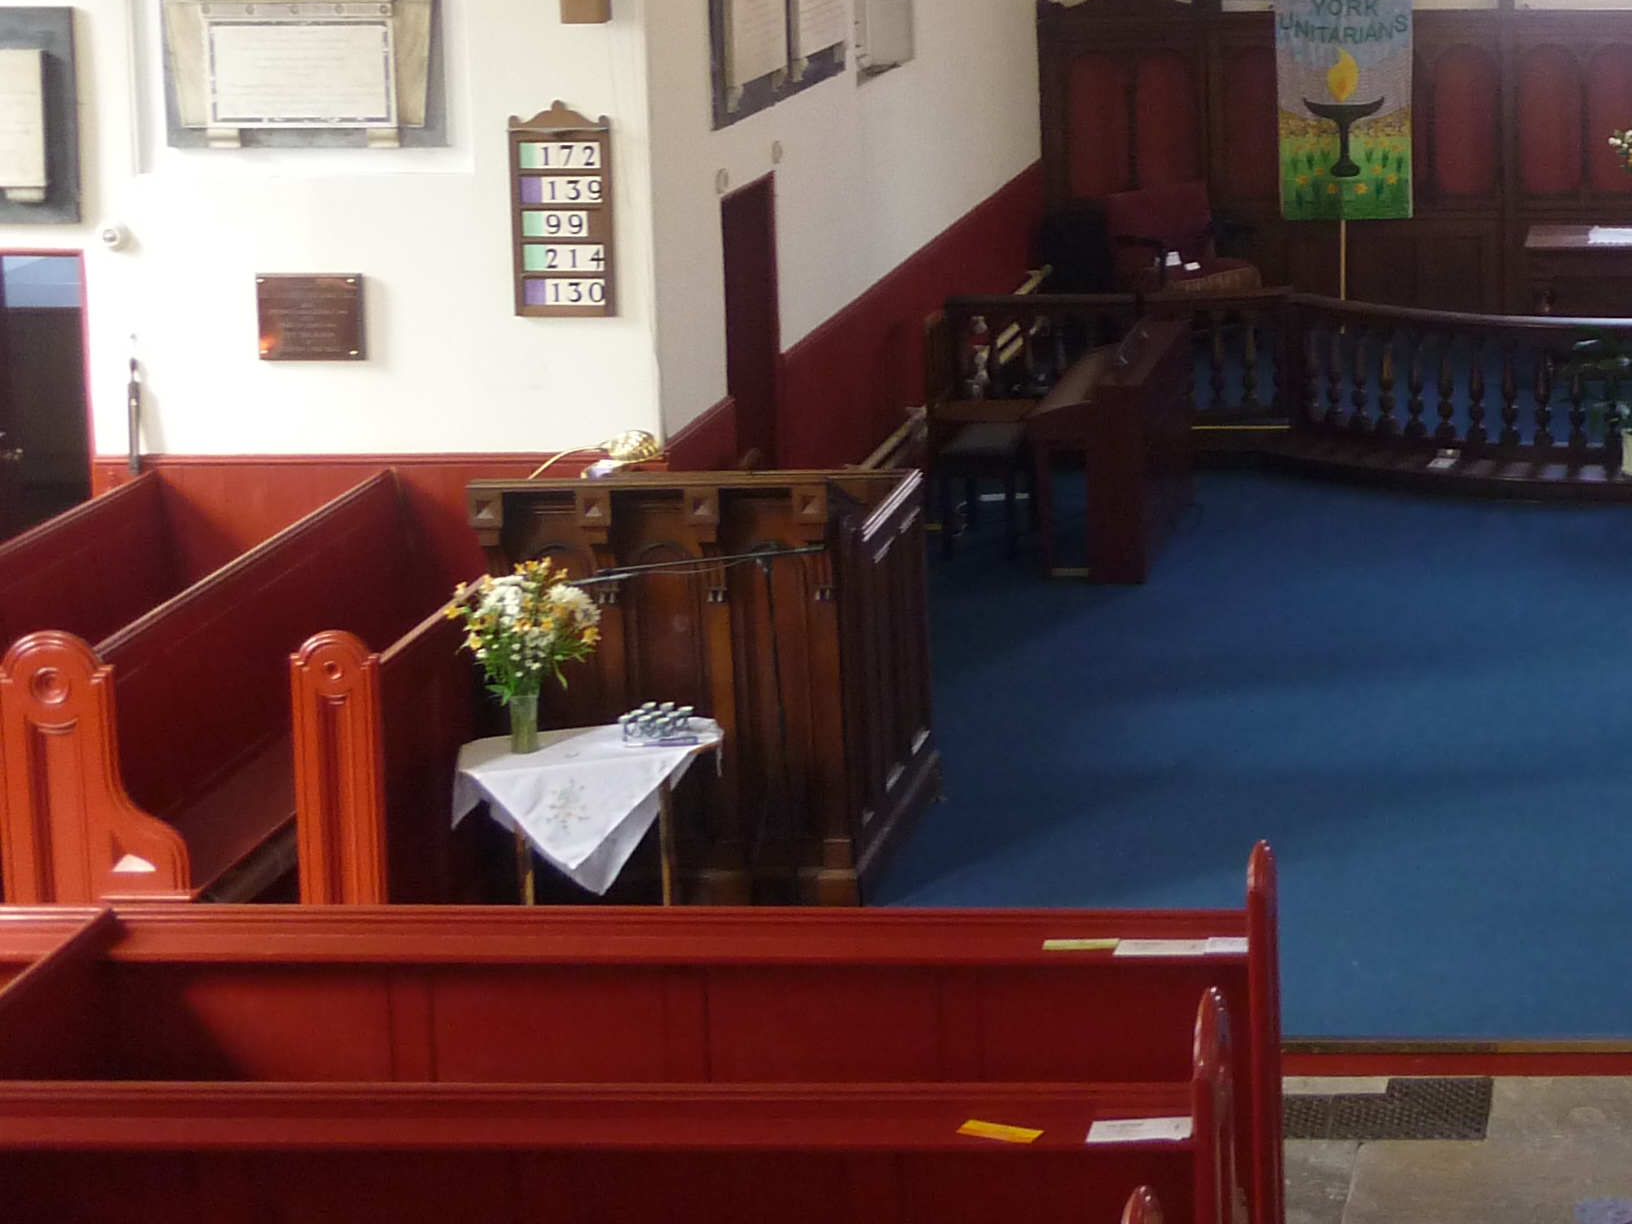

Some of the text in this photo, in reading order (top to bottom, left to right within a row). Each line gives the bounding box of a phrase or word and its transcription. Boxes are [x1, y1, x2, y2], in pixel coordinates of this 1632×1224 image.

[1279, 11, 1408, 43] UNITARIANS
[541, 145, 596, 166] 172
[548, 180, 602, 200] 139
[546, 214, 583, 234] 99
[545, 248, 604, 270] 214
[552, 282, 605, 302] 130
